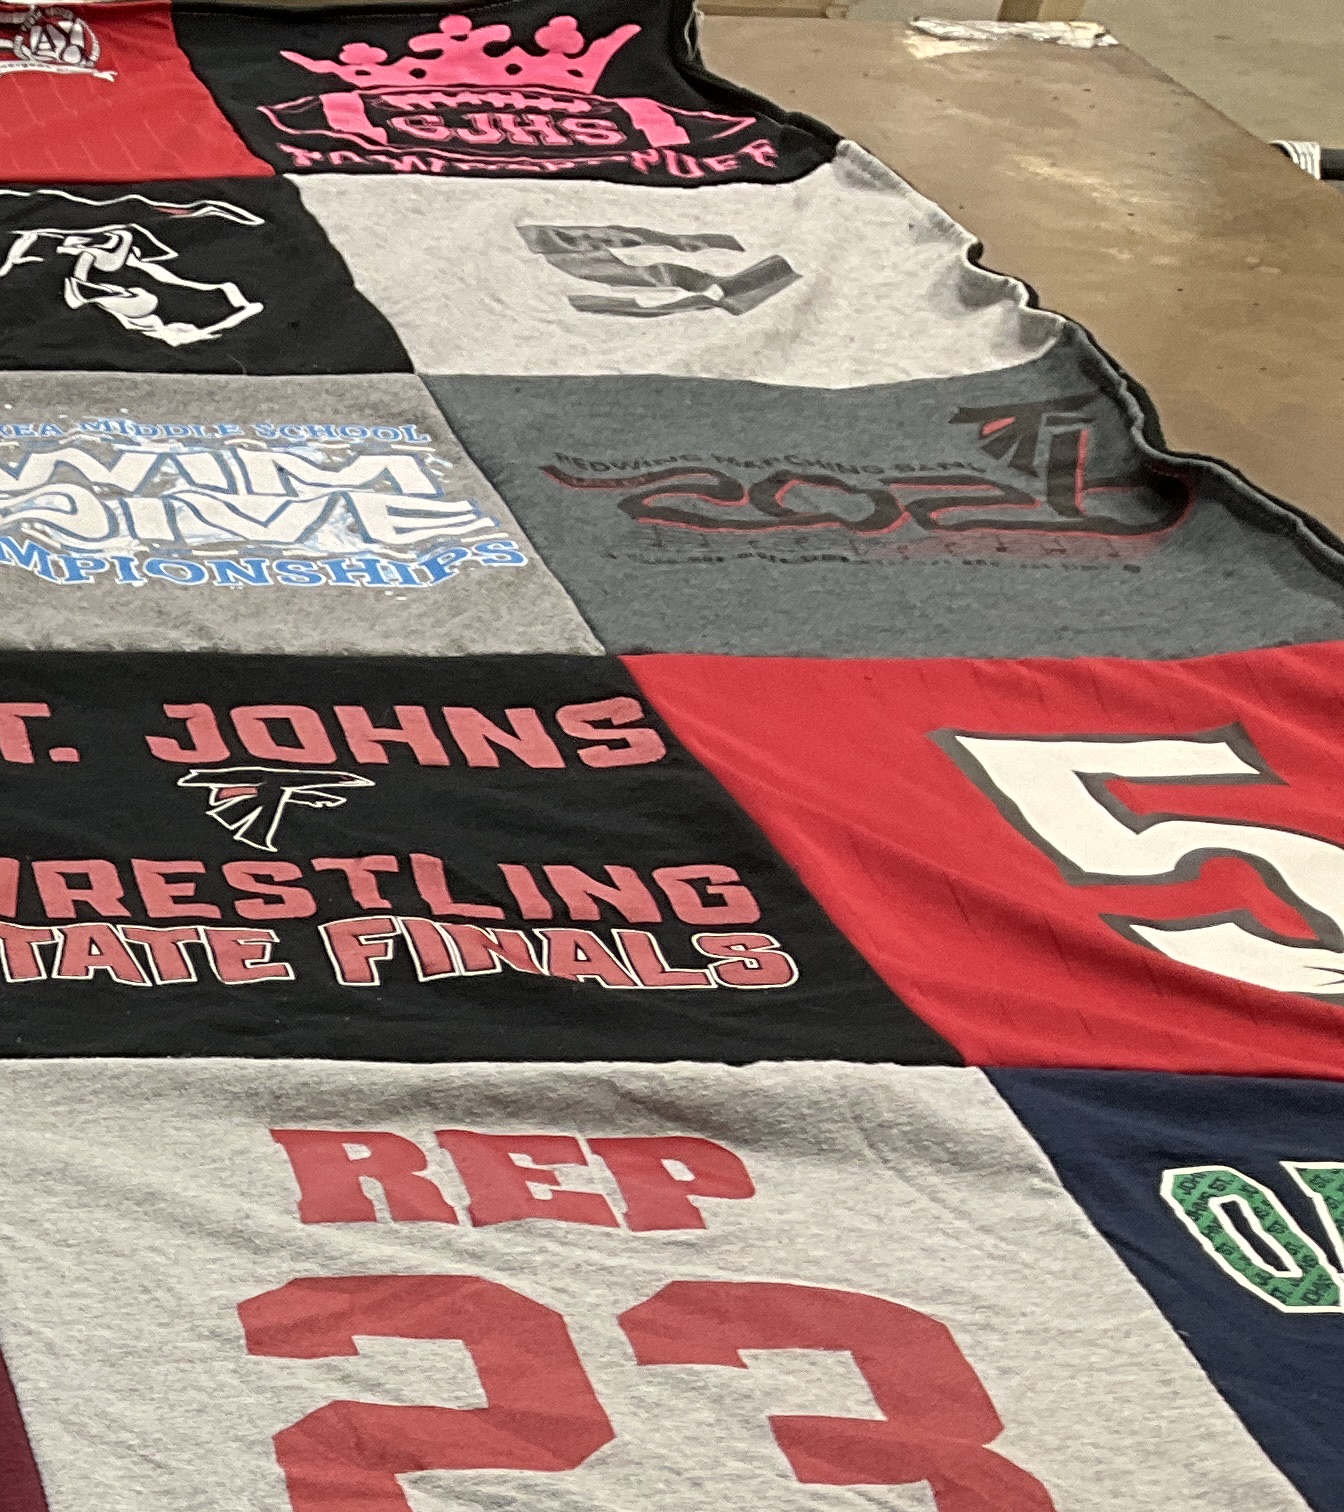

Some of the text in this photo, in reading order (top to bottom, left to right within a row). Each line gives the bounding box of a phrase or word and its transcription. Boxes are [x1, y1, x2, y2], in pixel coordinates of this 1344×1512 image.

[387, 111, 627, 146] GJHS
[79, 417, 247, 438] MIDDLE
[255, 422, 432, 443] SCHOOL
[145, 696, 669, 769] JOHNS
[924, 721, 1344, 1006] 5
[317, 915, 800, 990] FINALS
[269, 1127, 757, 1232] REP
